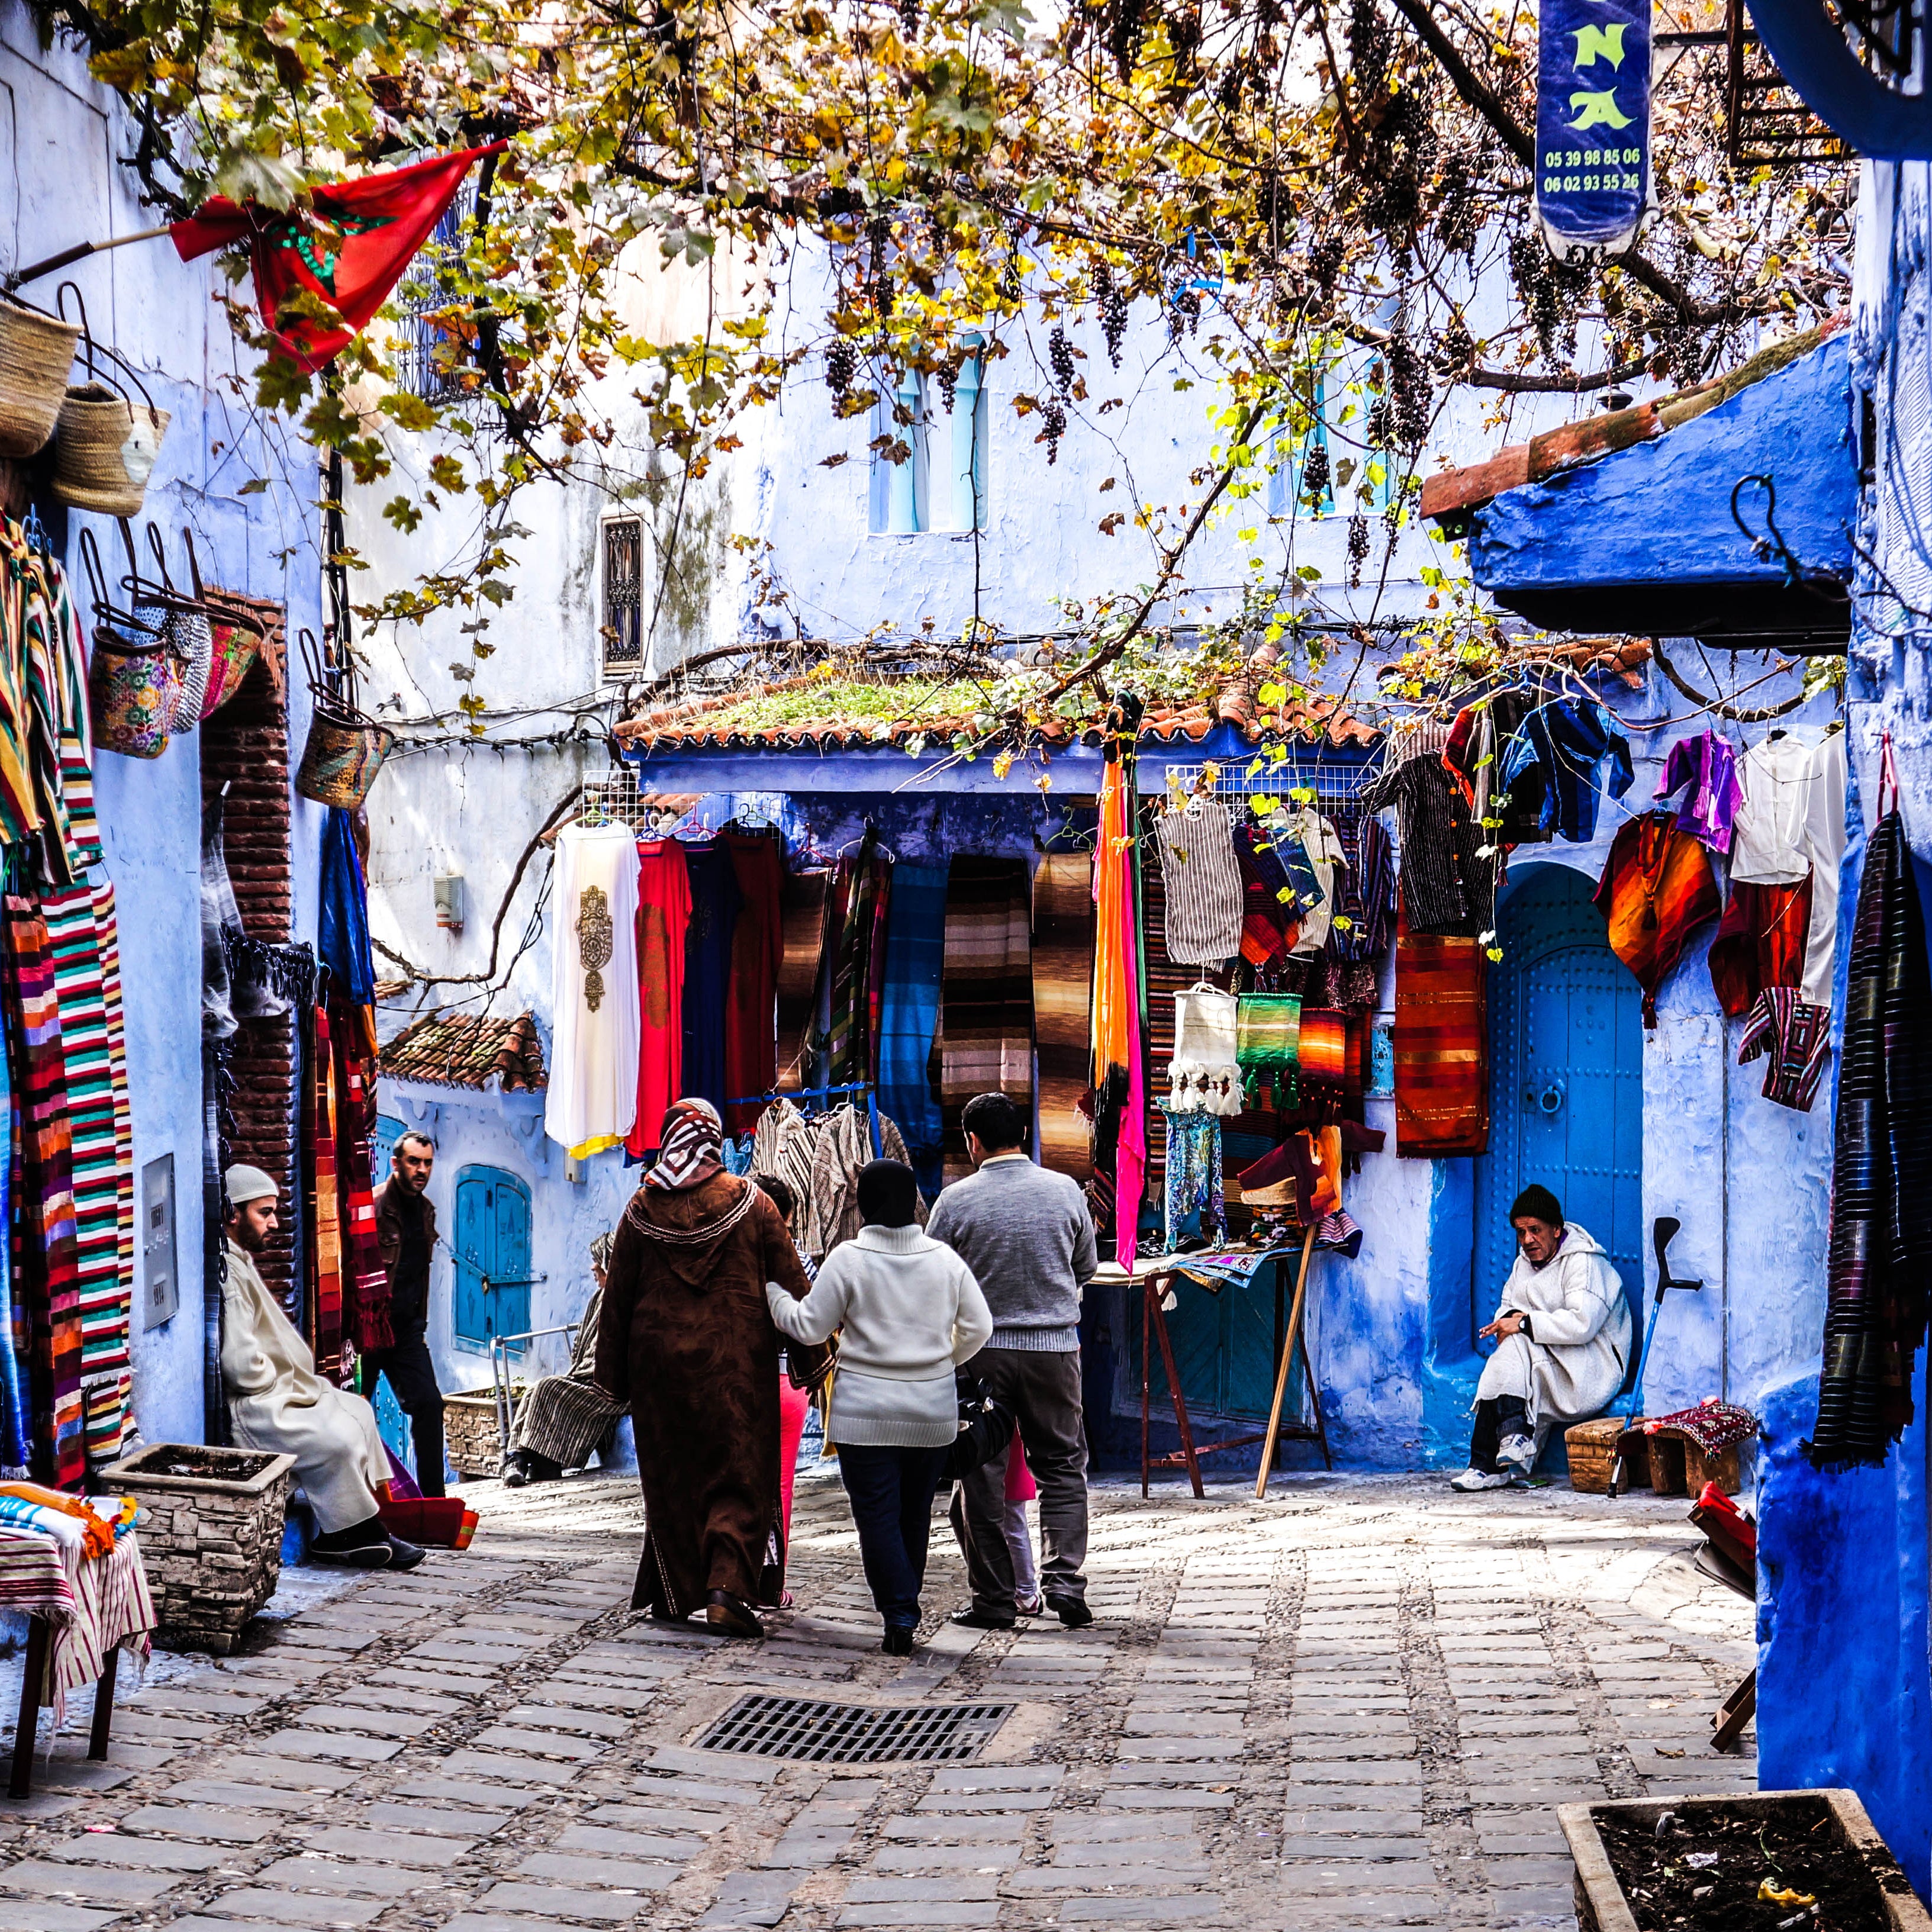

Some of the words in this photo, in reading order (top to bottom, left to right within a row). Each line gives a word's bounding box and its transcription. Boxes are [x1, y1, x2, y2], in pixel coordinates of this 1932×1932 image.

[1545, 152, 1562, 168] 05
[1565, 150, 1581, 167] 39
[1584, 149, 1601, 166] 98
[1603, 149, 1620, 165] 85
[1623, 148, 1640, 164] 06
[1544, 176, 1561, 193] 06
[1563, 176, 1580, 192] 02
[1583, 175, 1600, 191] 93
[1603, 174, 1619, 190] 55
[1622, 173, 1639, 189] 26
